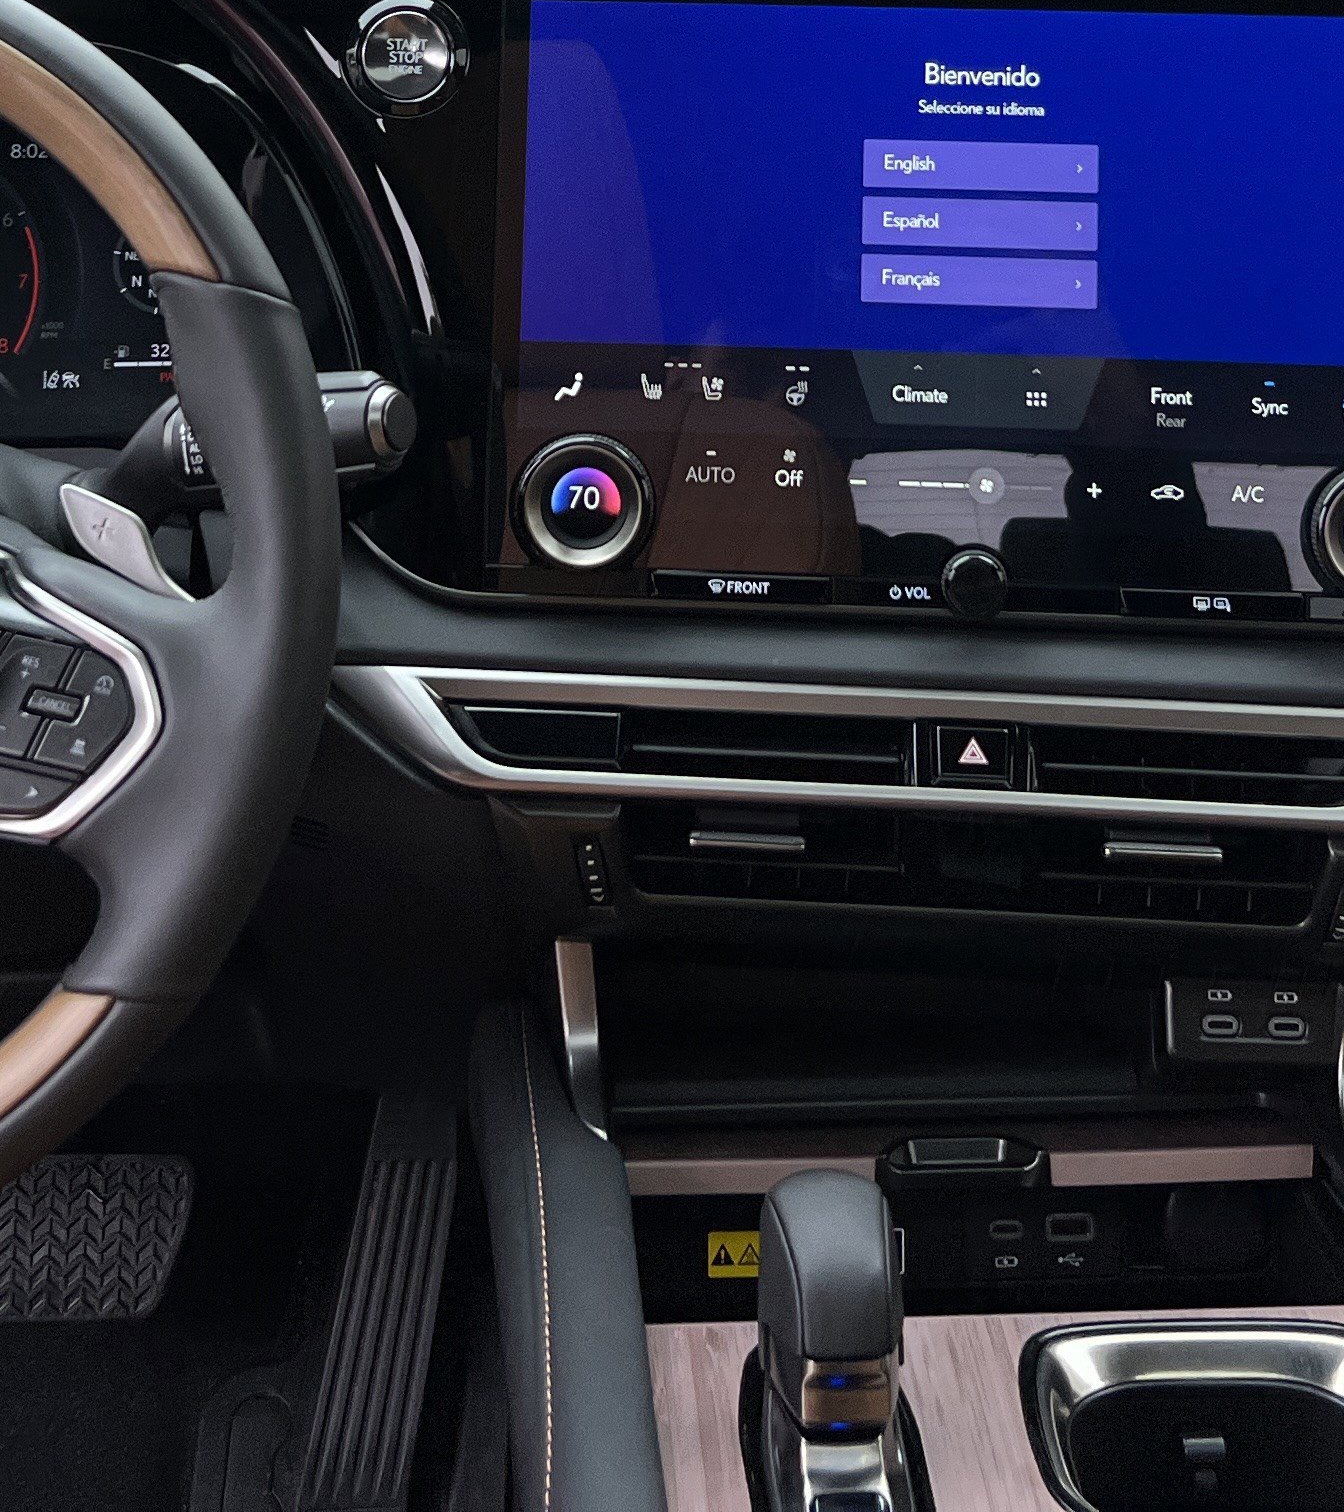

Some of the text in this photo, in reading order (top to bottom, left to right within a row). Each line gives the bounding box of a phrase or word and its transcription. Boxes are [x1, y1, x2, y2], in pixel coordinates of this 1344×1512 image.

[387, 38, 428, 51] START
[389, 51, 424, 64] STOP
[924, 62, 1041, 87] Bienvenido
[918, 99, 1045, 117] Seleccione su idioma
[884, 154, 936, 175] English
[2, 214, 14, 228] 6
[882, 212, 940, 232] Español
[18, 273, 29, 289] 7
[131, 275, 143, 288] N
[881, 268, 941, 291] Français
[892, 386, 948, 404] Climate
[1150, 387, 1193, 406] Front
[1251, 398, 1289, 417] Sync
[1156, 413, 1186, 428] Rear
[685, 467, 735, 484] AUTO
[775, 469, 804, 487] Off
[569, 486, 600, 510] 70
[1231, 486, 1265, 504] A/C
[726, 580, 770, 595] FRONT
[904, 587, 931, 600] VOL
[38, 695, 73, 711] CANCEL
